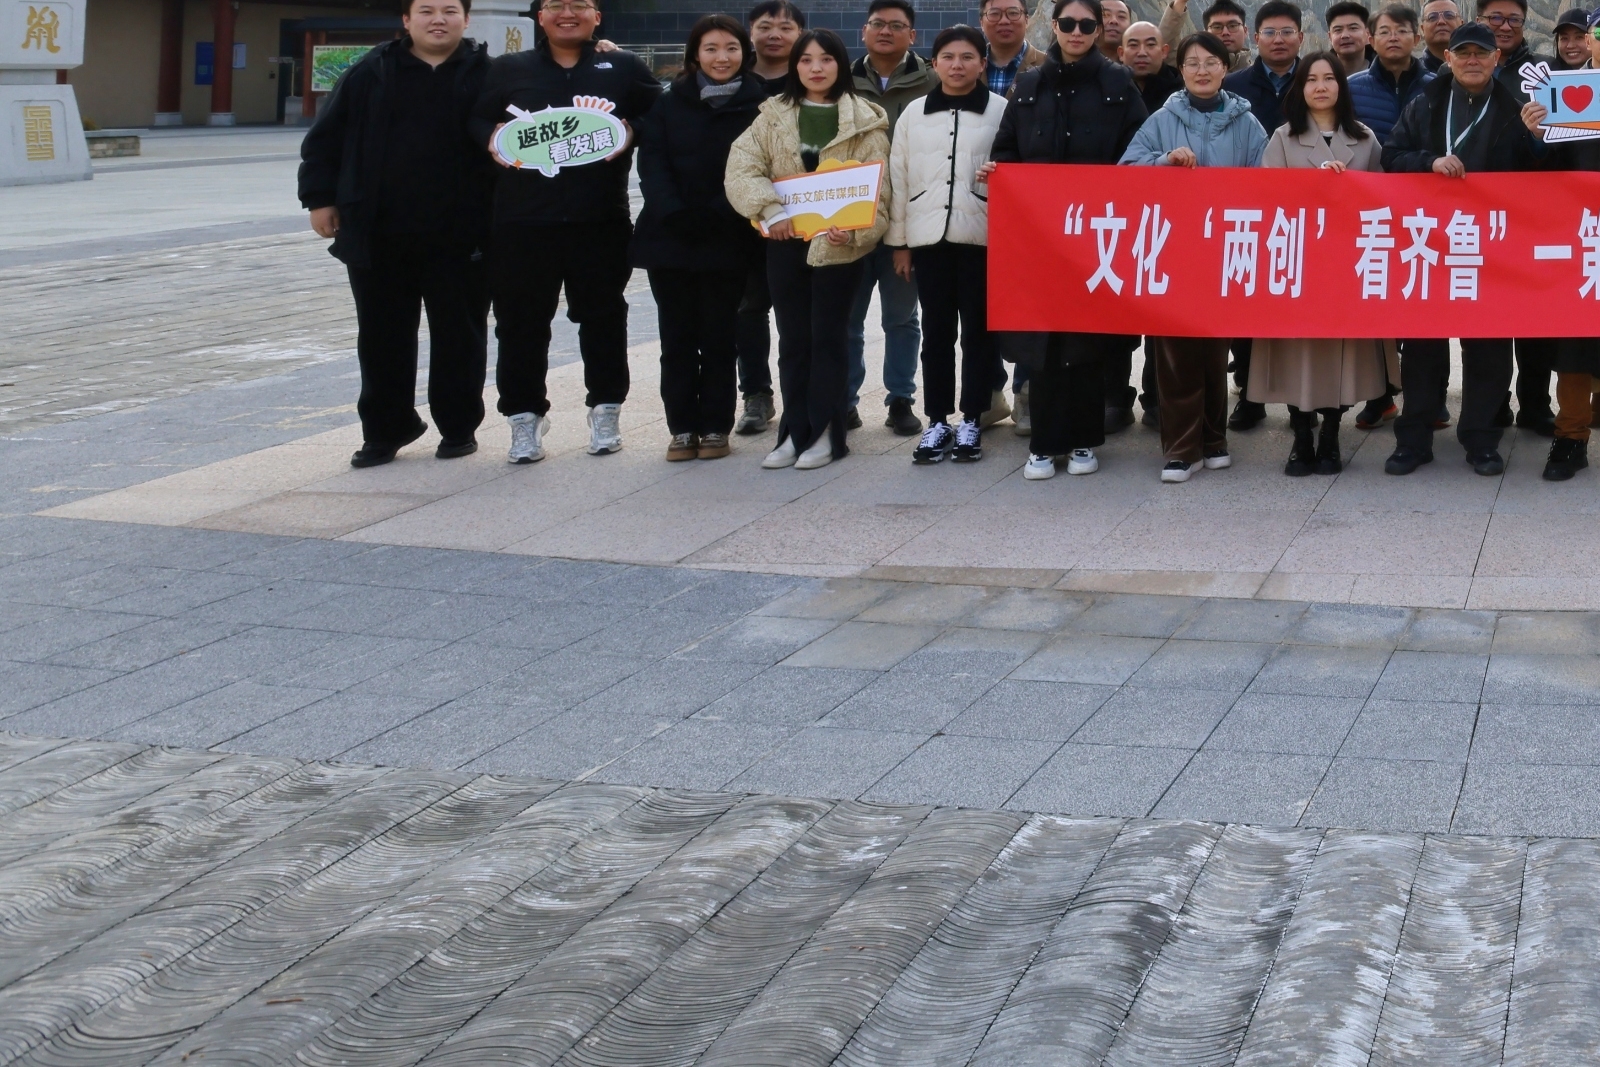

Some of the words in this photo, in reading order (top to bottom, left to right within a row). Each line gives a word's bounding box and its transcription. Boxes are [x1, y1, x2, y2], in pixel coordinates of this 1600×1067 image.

[517, 115, 580, 150] 返故乡
[549, 127, 614, 164] 看发展
[781, 184, 870, 206] 山东文旅传媒集团
